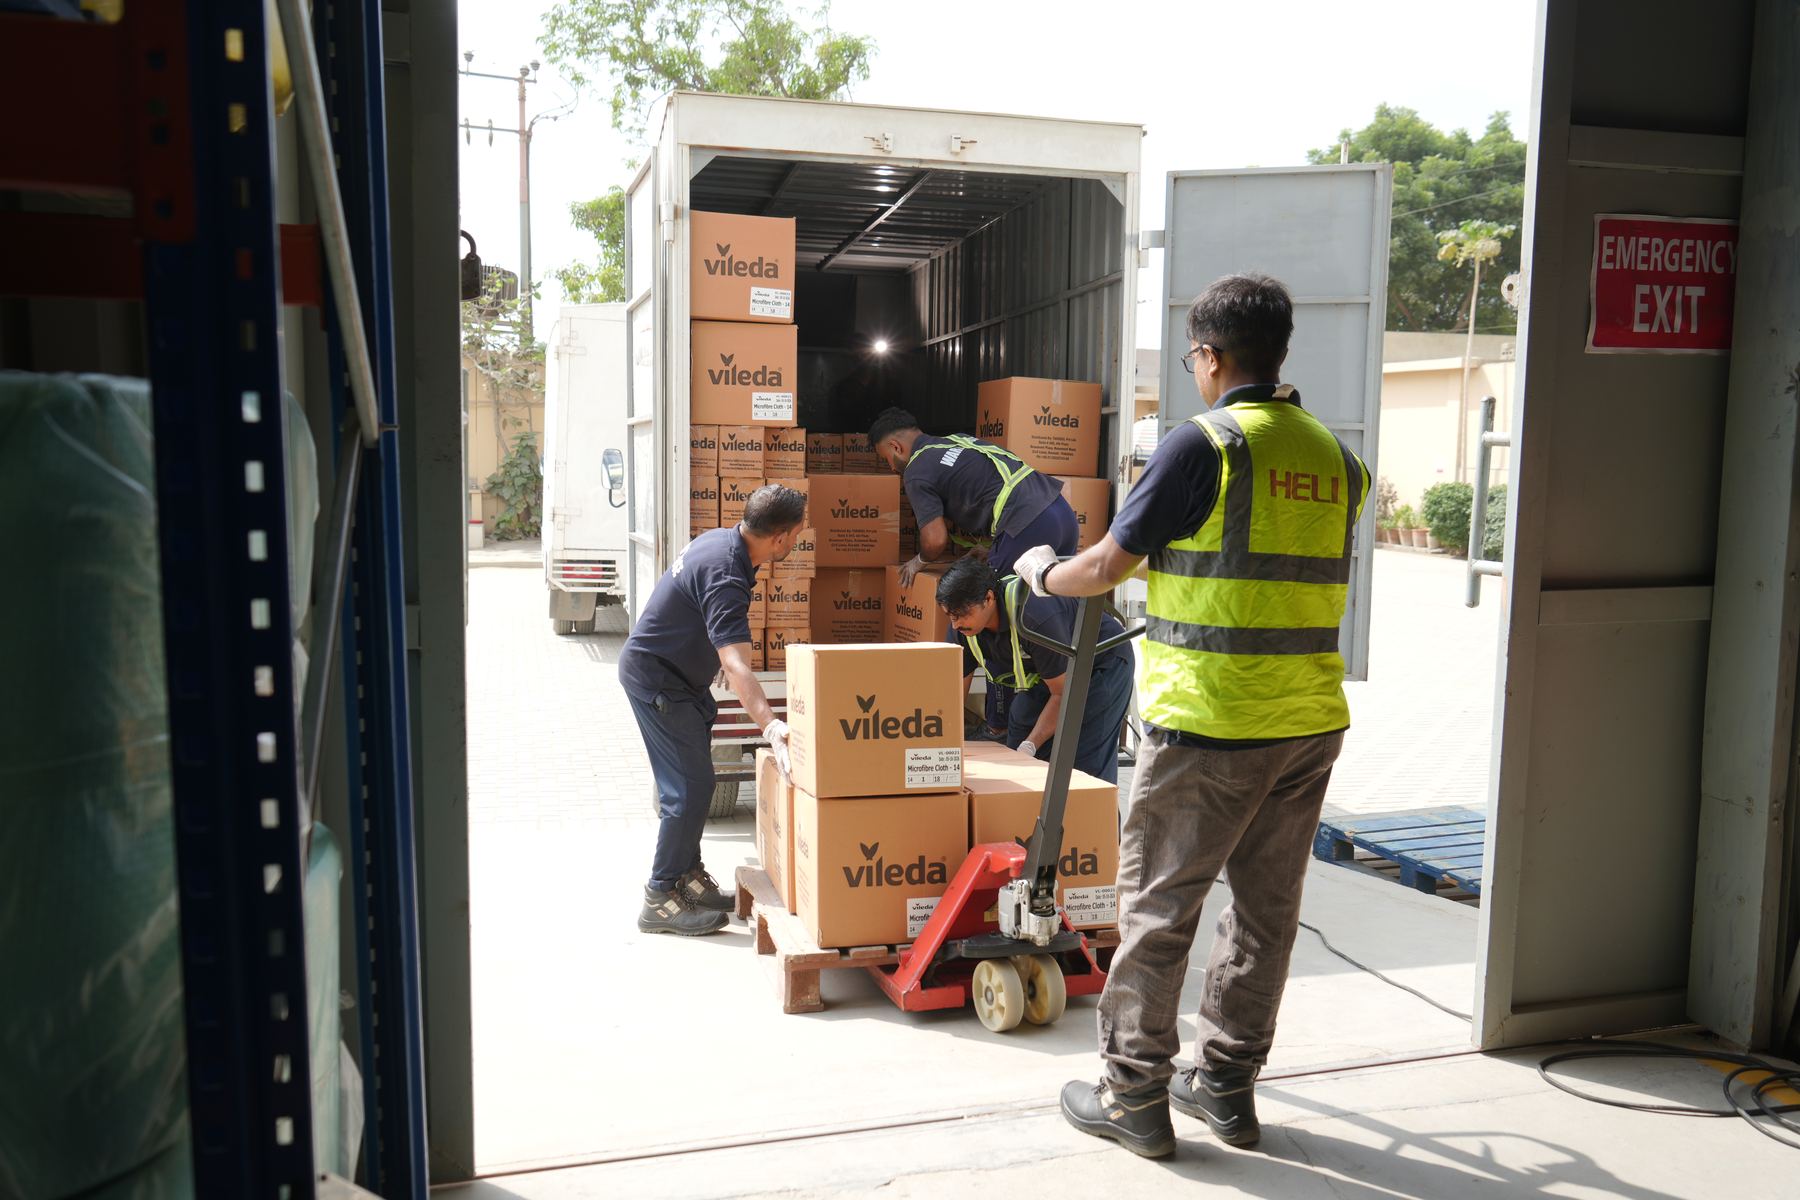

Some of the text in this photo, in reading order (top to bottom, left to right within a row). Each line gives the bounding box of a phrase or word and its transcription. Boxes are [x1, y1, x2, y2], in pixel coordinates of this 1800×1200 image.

[704, 243, 779, 279] vileda
[1600, 235, 1739, 274] EMERGENCY
[1632, 284, 1706, 334] EXIT
[708, 353, 782, 387] vileda
[980, 410, 1003, 438] vileda
[1033, 405, 1079, 429] vileda
[691, 437, 716, 449] eda
[722, 433, 762, 452] vileda
[766, 434, 804, 452] vileda
[809, 440, 841, 454] vileda
[723, 483, 750, 501] vile
[1269, 469, 1339, 504] HELI
[830, 499, 879, 519] vileda
[769, 585, 808, 602] vileda
[833, 591, 881, 610] vileda
[896, 595, 923, 620] vileda
[839, 694, 943, 740] vileda
[843, 842, 947, 888] vileda
[1066, 903, 1091, 911] Microfibre
